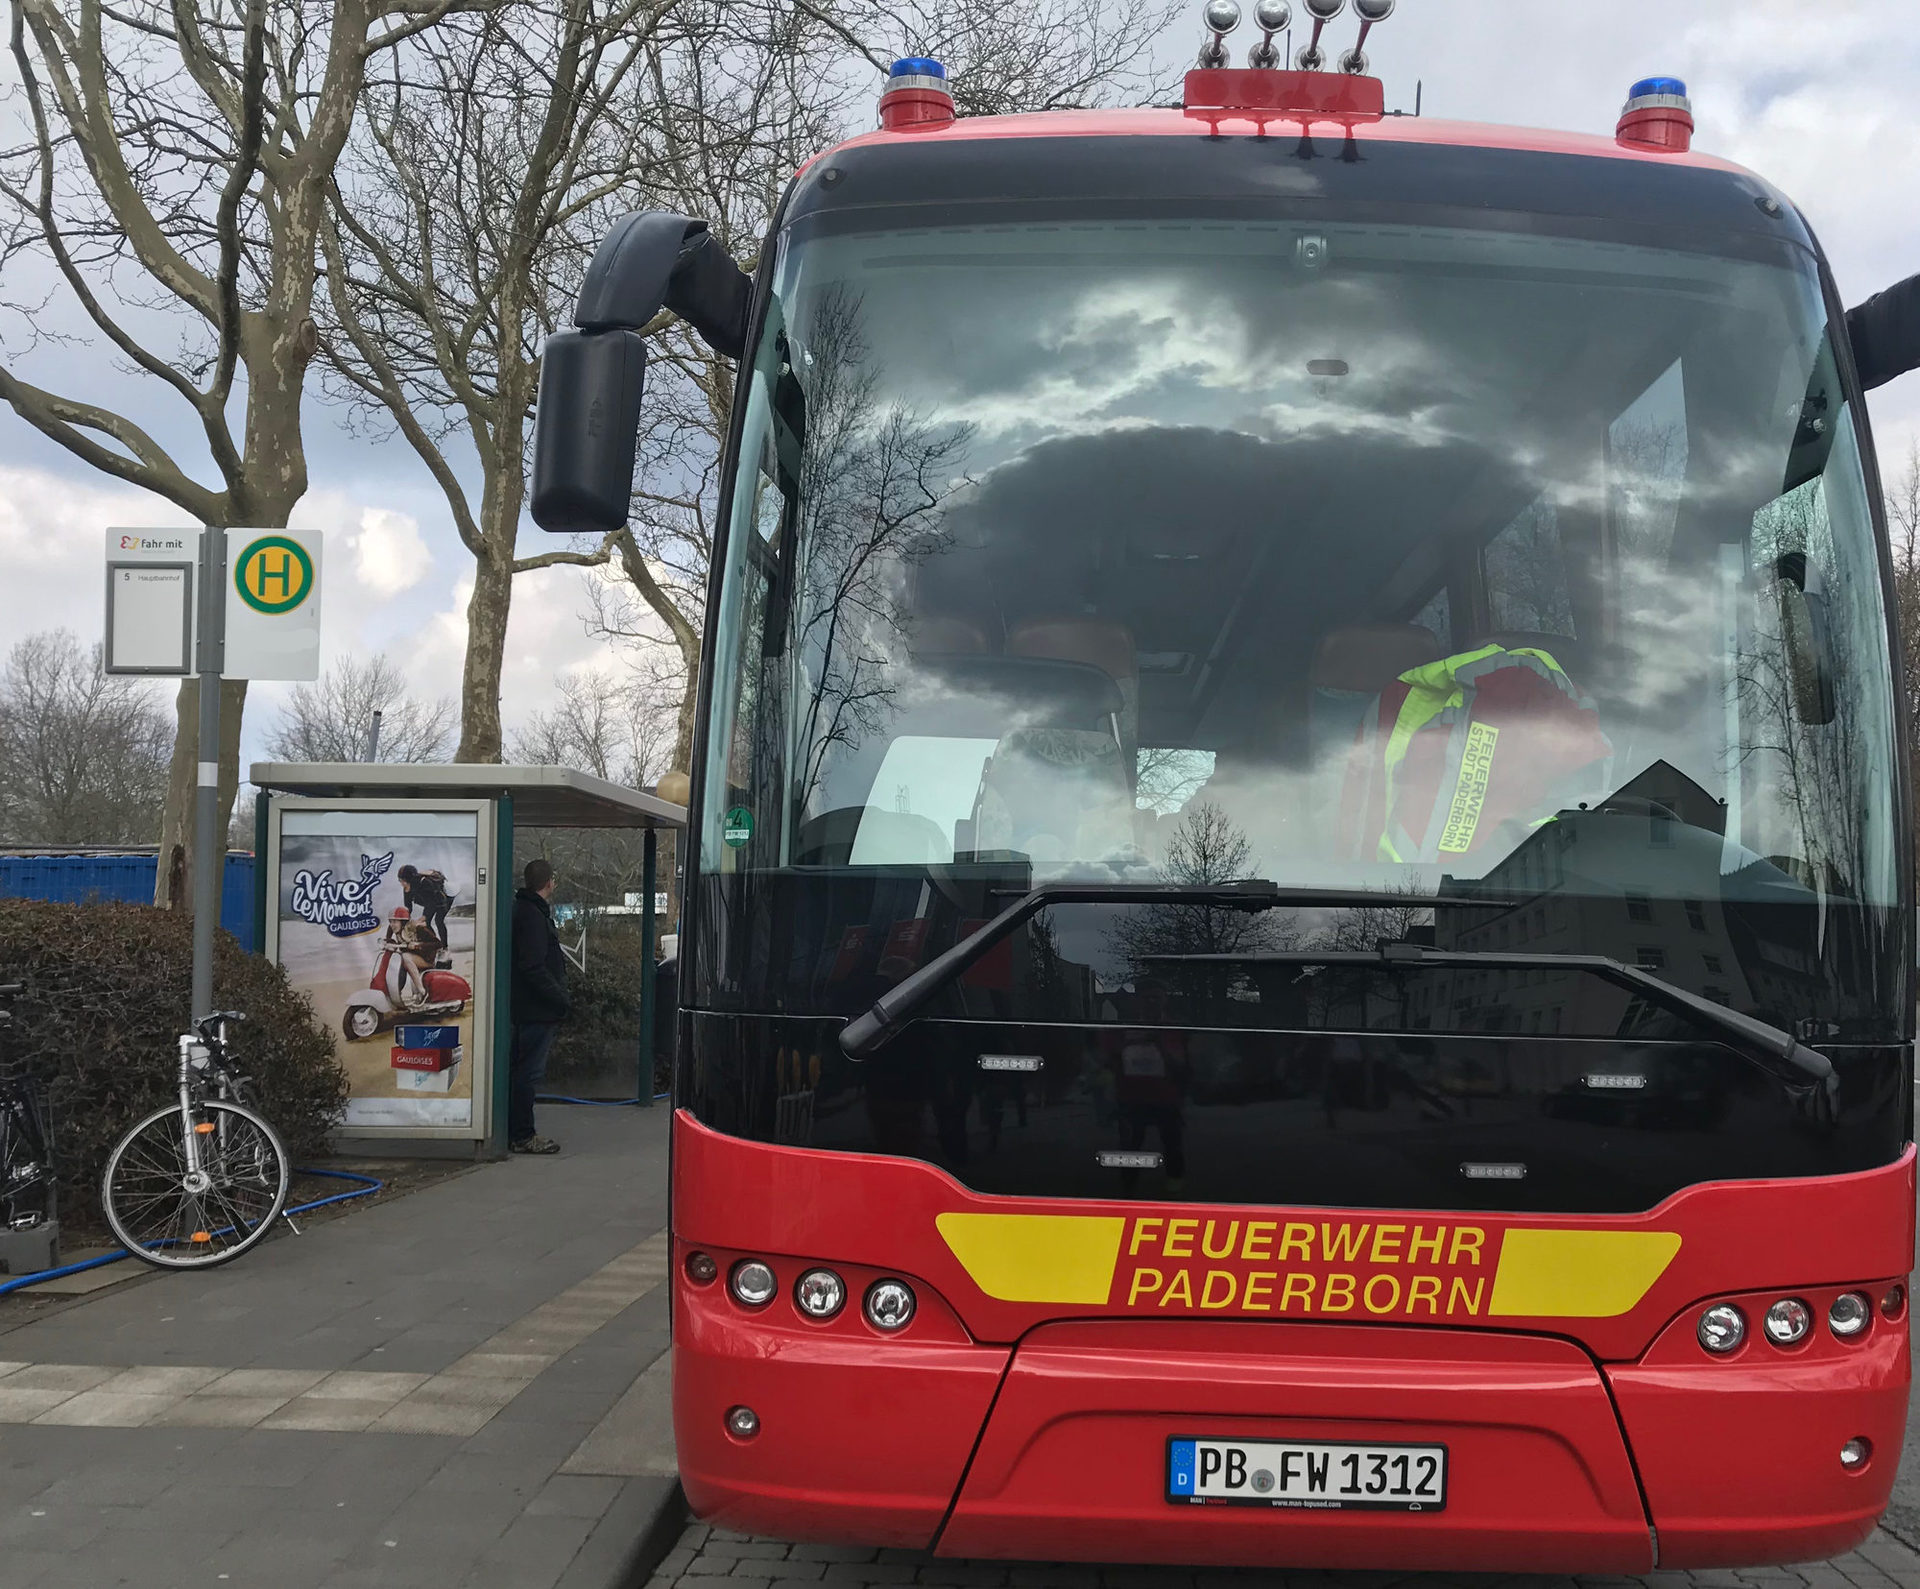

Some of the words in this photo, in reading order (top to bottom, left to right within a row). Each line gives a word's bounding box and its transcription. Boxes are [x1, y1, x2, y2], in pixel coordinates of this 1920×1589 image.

[141, 538, 162, 549] fahr
[165, 538, 183, 549] mit
[124, 572, 130, 581] 5
[137, 575, 180, 583] Hauptbahnhof
[257, 553, 290, 597] H
[1464, 726, 1483, 771] STADT
[1441, 772, 1473, 848] PADERBORN
[1455, 730, 1496, 850] FEUERWEHR
[294, 869, 380, 904] Vive
[329, 918, 377, 932] GAULOISES
[396, 1055, 433, 1066] GAULOISES
[1128, 1217, 1485, 1266] FEUERWEHR
[1127, 1267, 1485, 1316] PADERBORN
[1177, 1472, 1187, 1486] D
[1199, 1447, 1247, 1490] PB
[1280, 1450, 1330, 1493] FW
[1339, 1453, 1439, 1497] 1312
